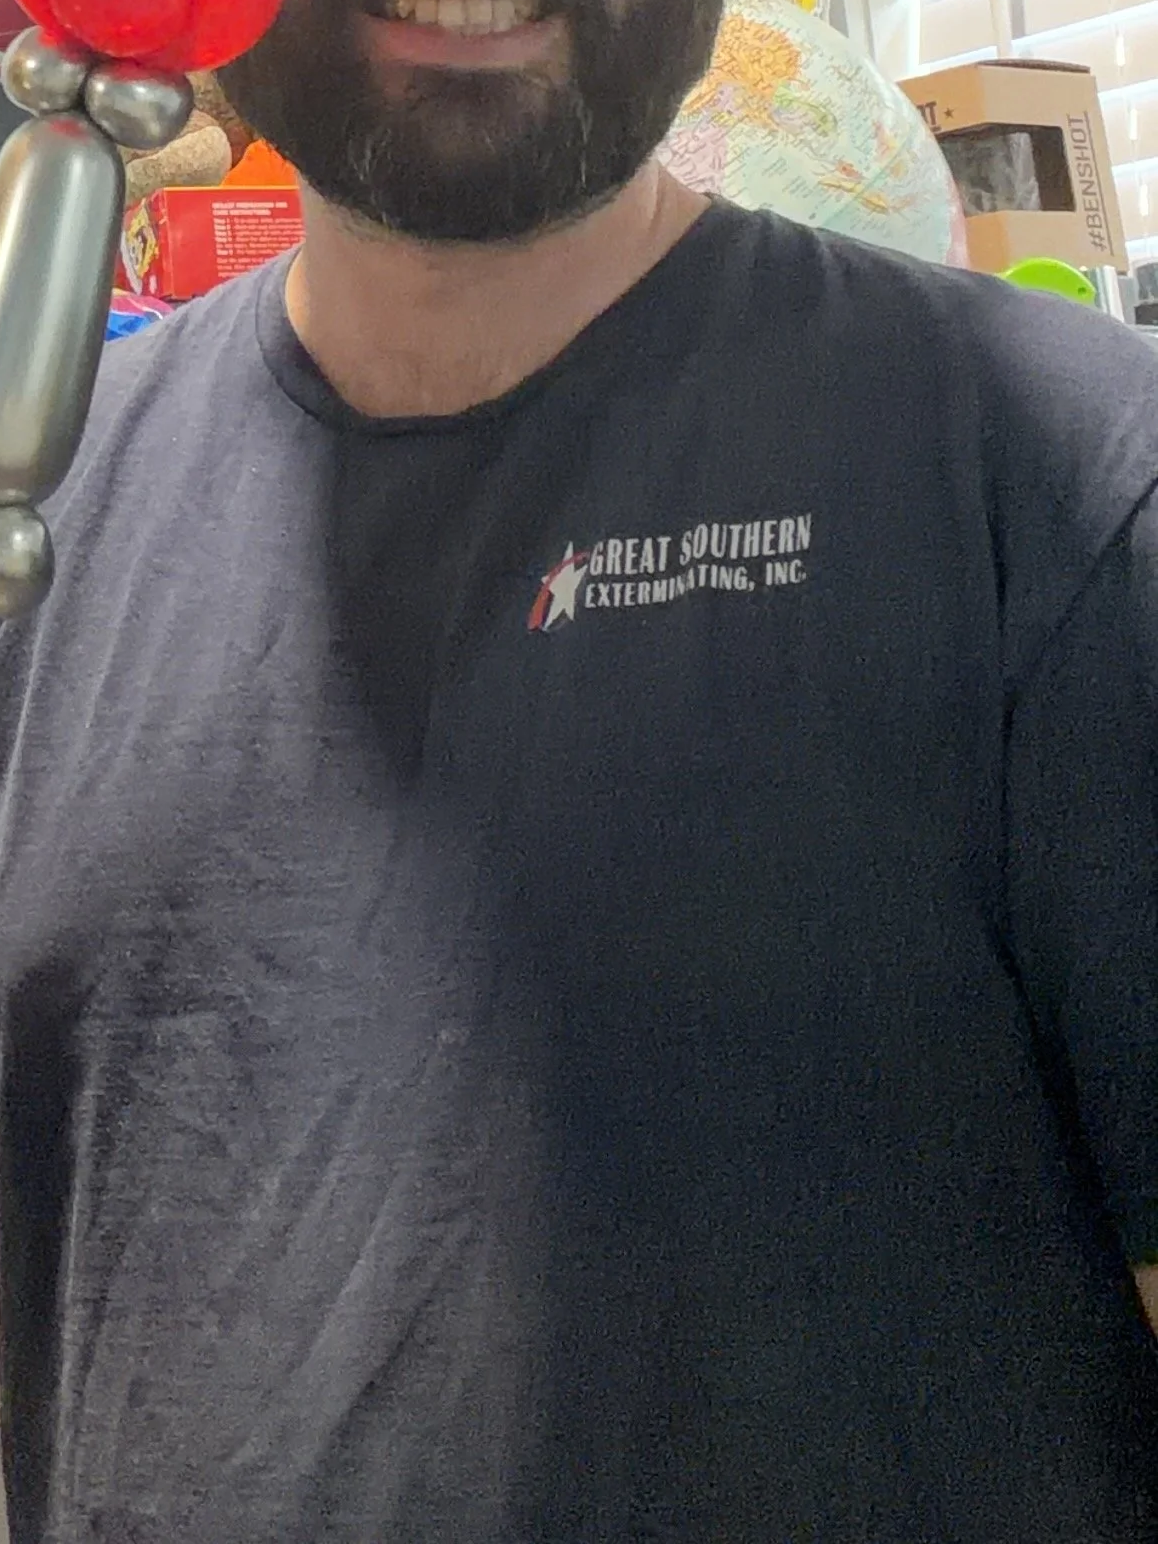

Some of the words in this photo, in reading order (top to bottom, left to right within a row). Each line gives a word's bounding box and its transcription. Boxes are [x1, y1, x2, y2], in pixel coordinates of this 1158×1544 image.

[1066, 113, 1107, 252] #BENSHOT
[589, 536, 672, 577] GREAT
[679, 512, 813, 567] SOUTHERN
[584, 563, 756, 609] EXTERMINATING,
[765, 558, 807, 586] INC.
